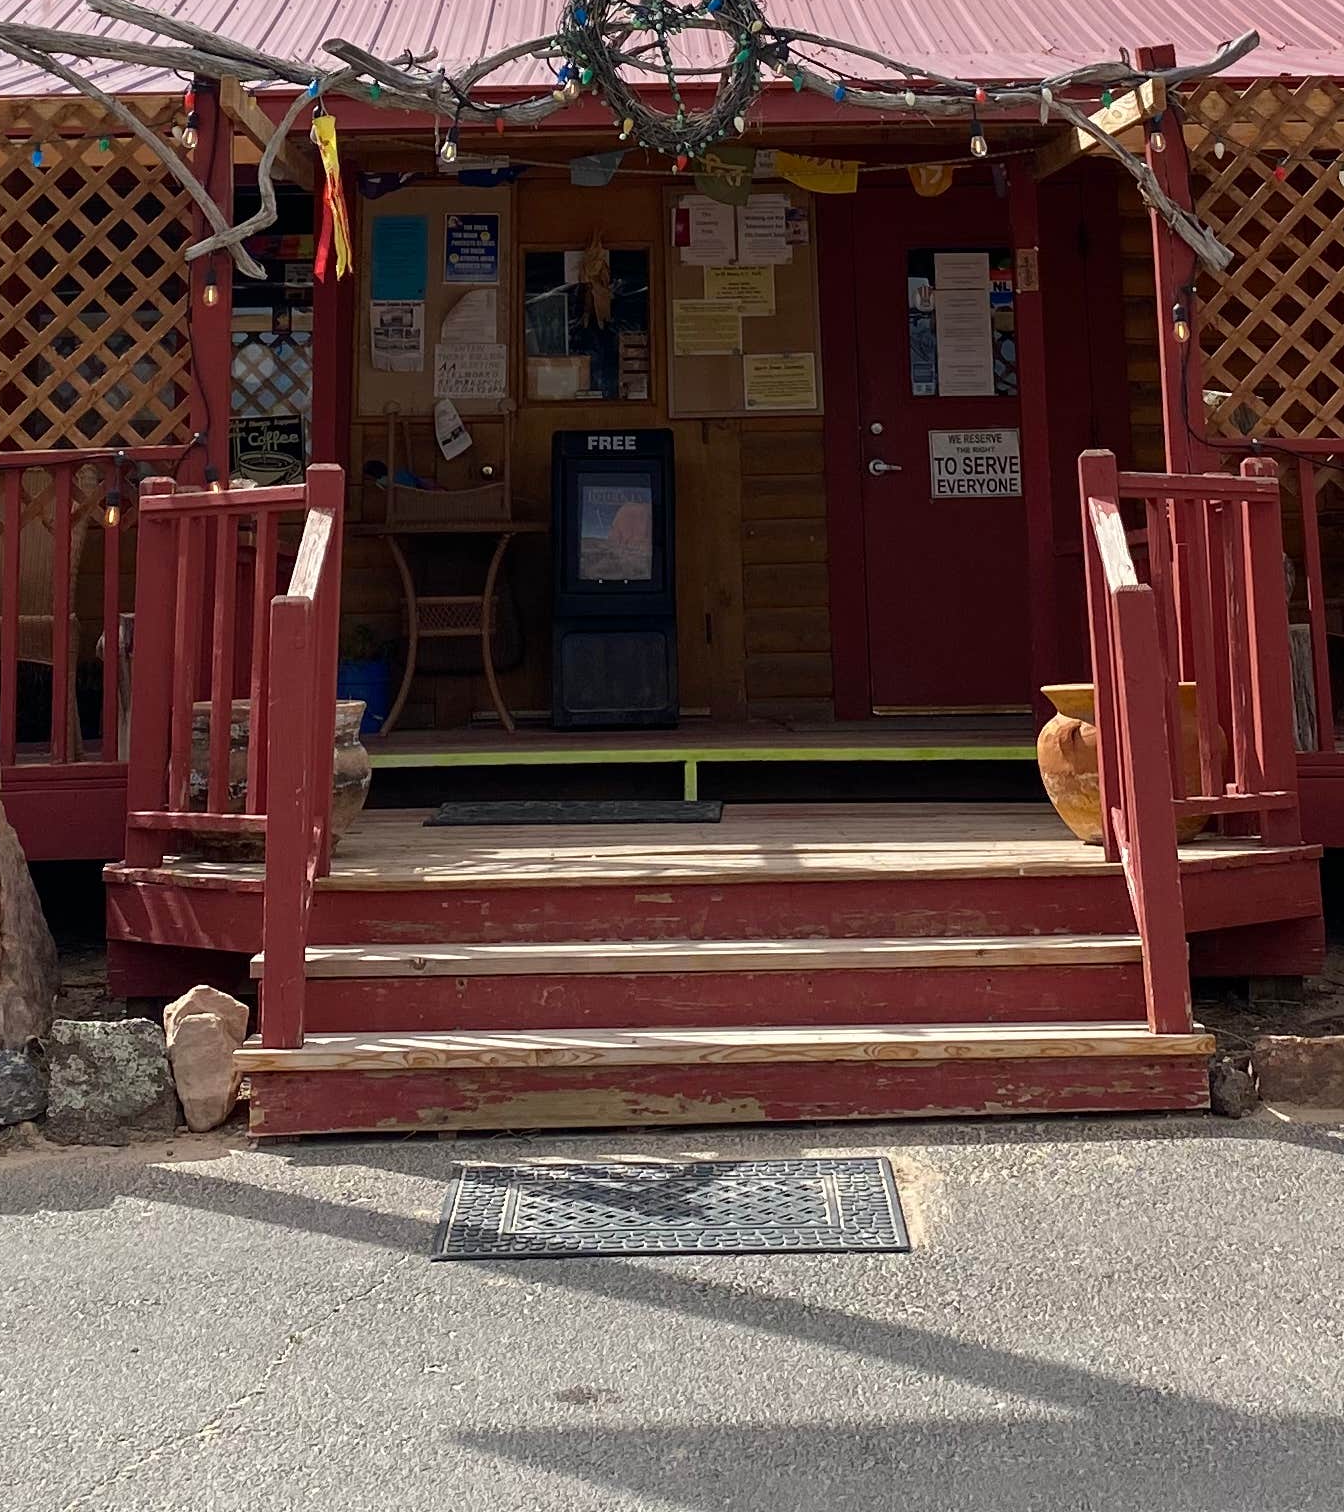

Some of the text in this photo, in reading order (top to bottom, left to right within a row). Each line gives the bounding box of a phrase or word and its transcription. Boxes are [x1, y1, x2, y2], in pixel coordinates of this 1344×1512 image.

[993, 281, 1011, 291] NL
[247, 430, 300, 451] Coffee
[587, 435, 637, 450] FREE
[948, 433, 1003, 444] WE RESERVE
[972, 446, 996, 454] RIGHT
[934, 456, 1020, 475] TO SERVE
[937, 478, 1019, 493] EVERYONE
